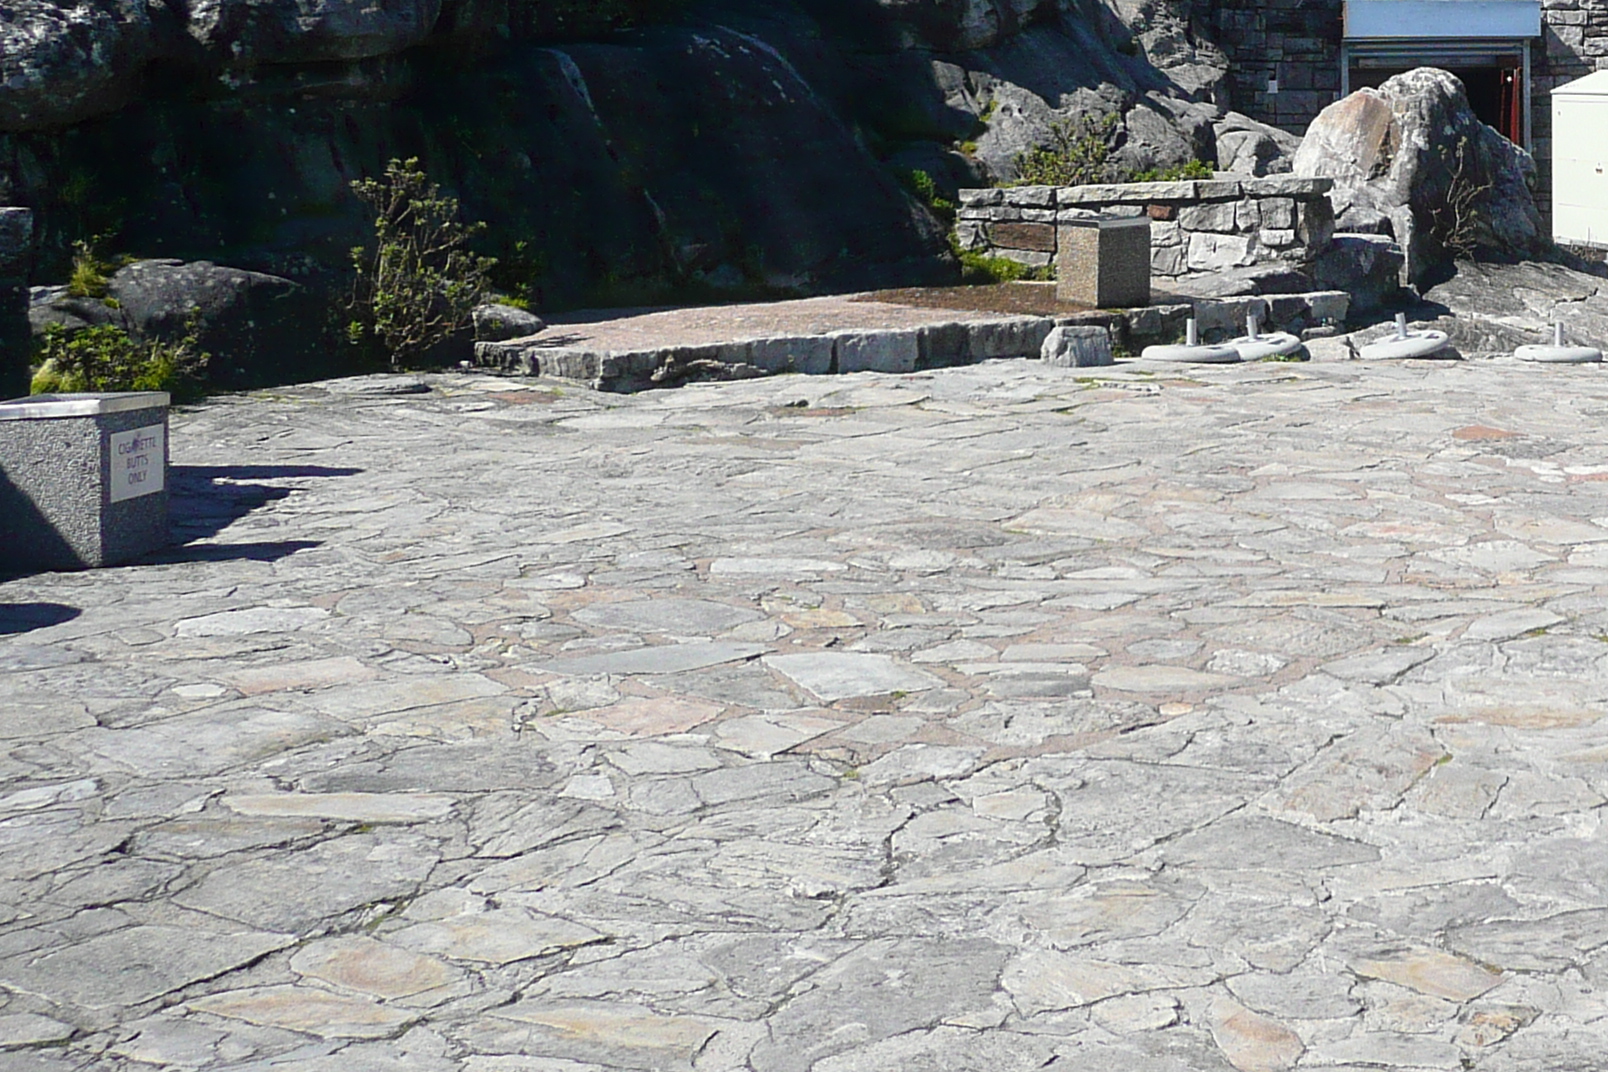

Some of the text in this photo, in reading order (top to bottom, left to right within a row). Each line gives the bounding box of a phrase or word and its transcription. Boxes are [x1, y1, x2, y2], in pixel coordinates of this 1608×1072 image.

[118, 436, 156, 455] CIGETTE
[127, 454, 148, 469] BUTTS
[128, 470, 147, 485] ONLY
